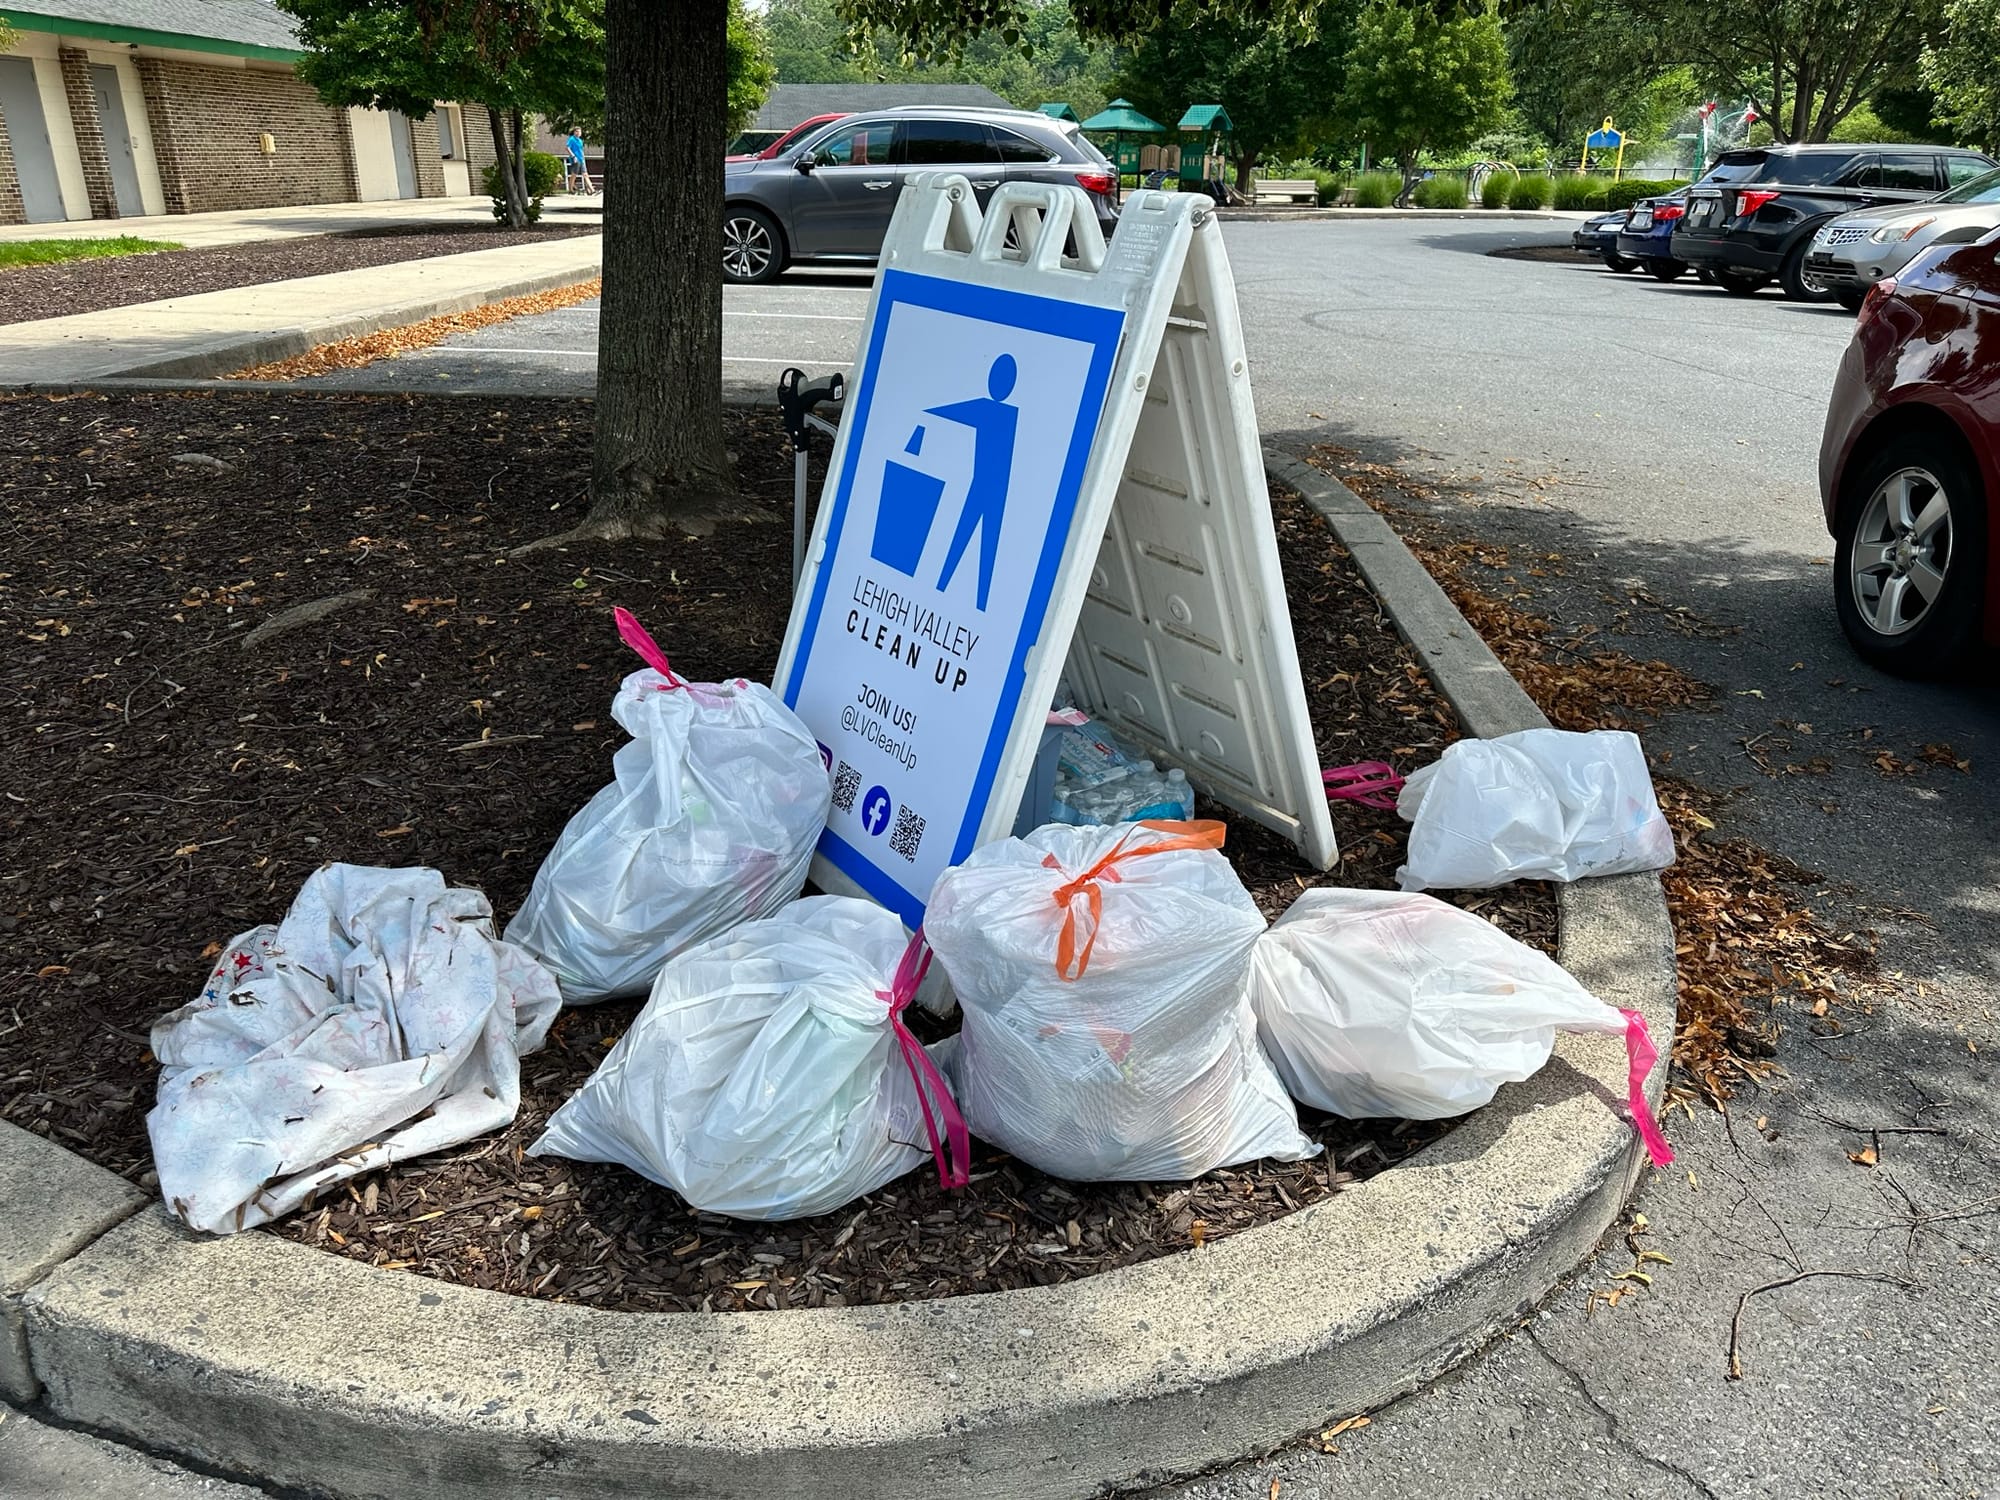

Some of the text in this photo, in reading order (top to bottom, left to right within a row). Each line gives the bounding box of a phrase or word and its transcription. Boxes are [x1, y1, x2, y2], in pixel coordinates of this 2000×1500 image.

[846, 609, 967, 692] CLEAN UP
[853, 575, 979, 660] LEHIGH VALLEY
[841, 705, 917, 772] @LVCleanUp
[857, 683, 917, 735] JOIN US!
